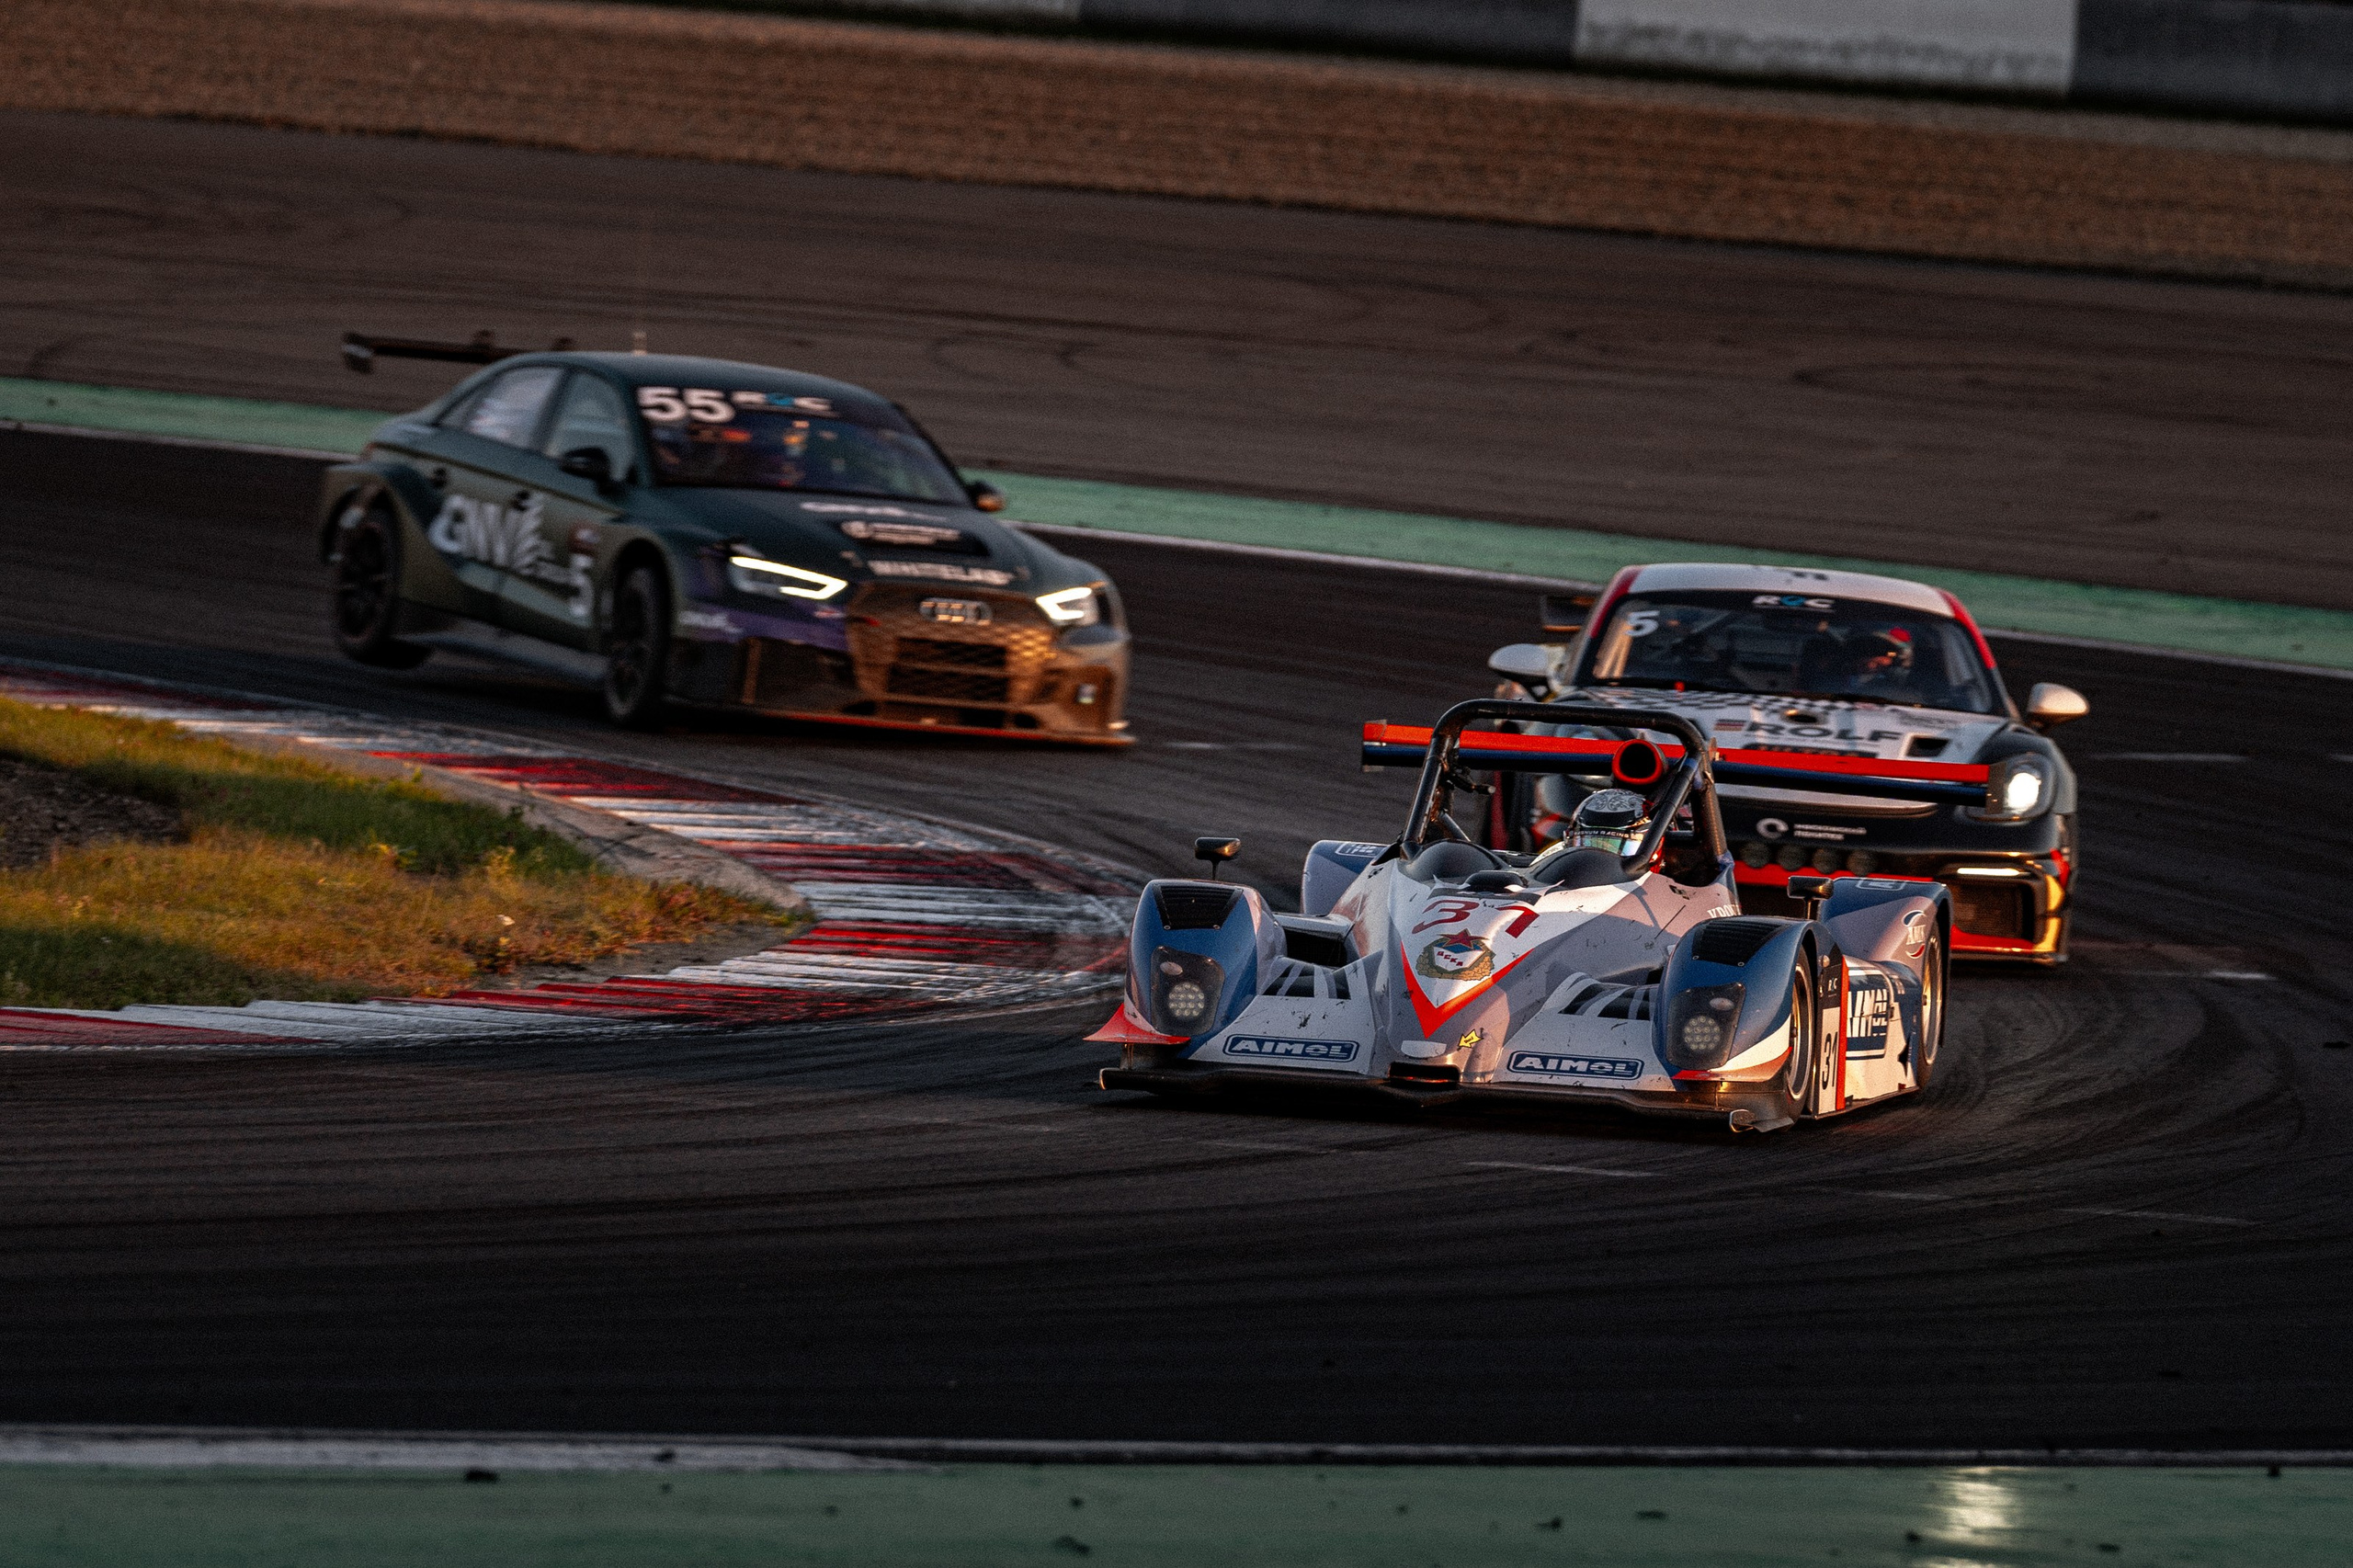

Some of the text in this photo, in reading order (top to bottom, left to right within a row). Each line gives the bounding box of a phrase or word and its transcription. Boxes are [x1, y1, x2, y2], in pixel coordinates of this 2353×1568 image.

[637, 386, 734, 423] 55
[1624, 610, 1660, 637] 5
[1746, 722, 1903, 742] ROLF
[1599, 830, 1630, 838] RACING
[1412, 900, 1540, 938] 31
[1232, 1040, 1348, 1058] AIMOL
[1822, 1031, 1838, 1090] 31
[1516, 1057, 1632, 1075] AIMOL
